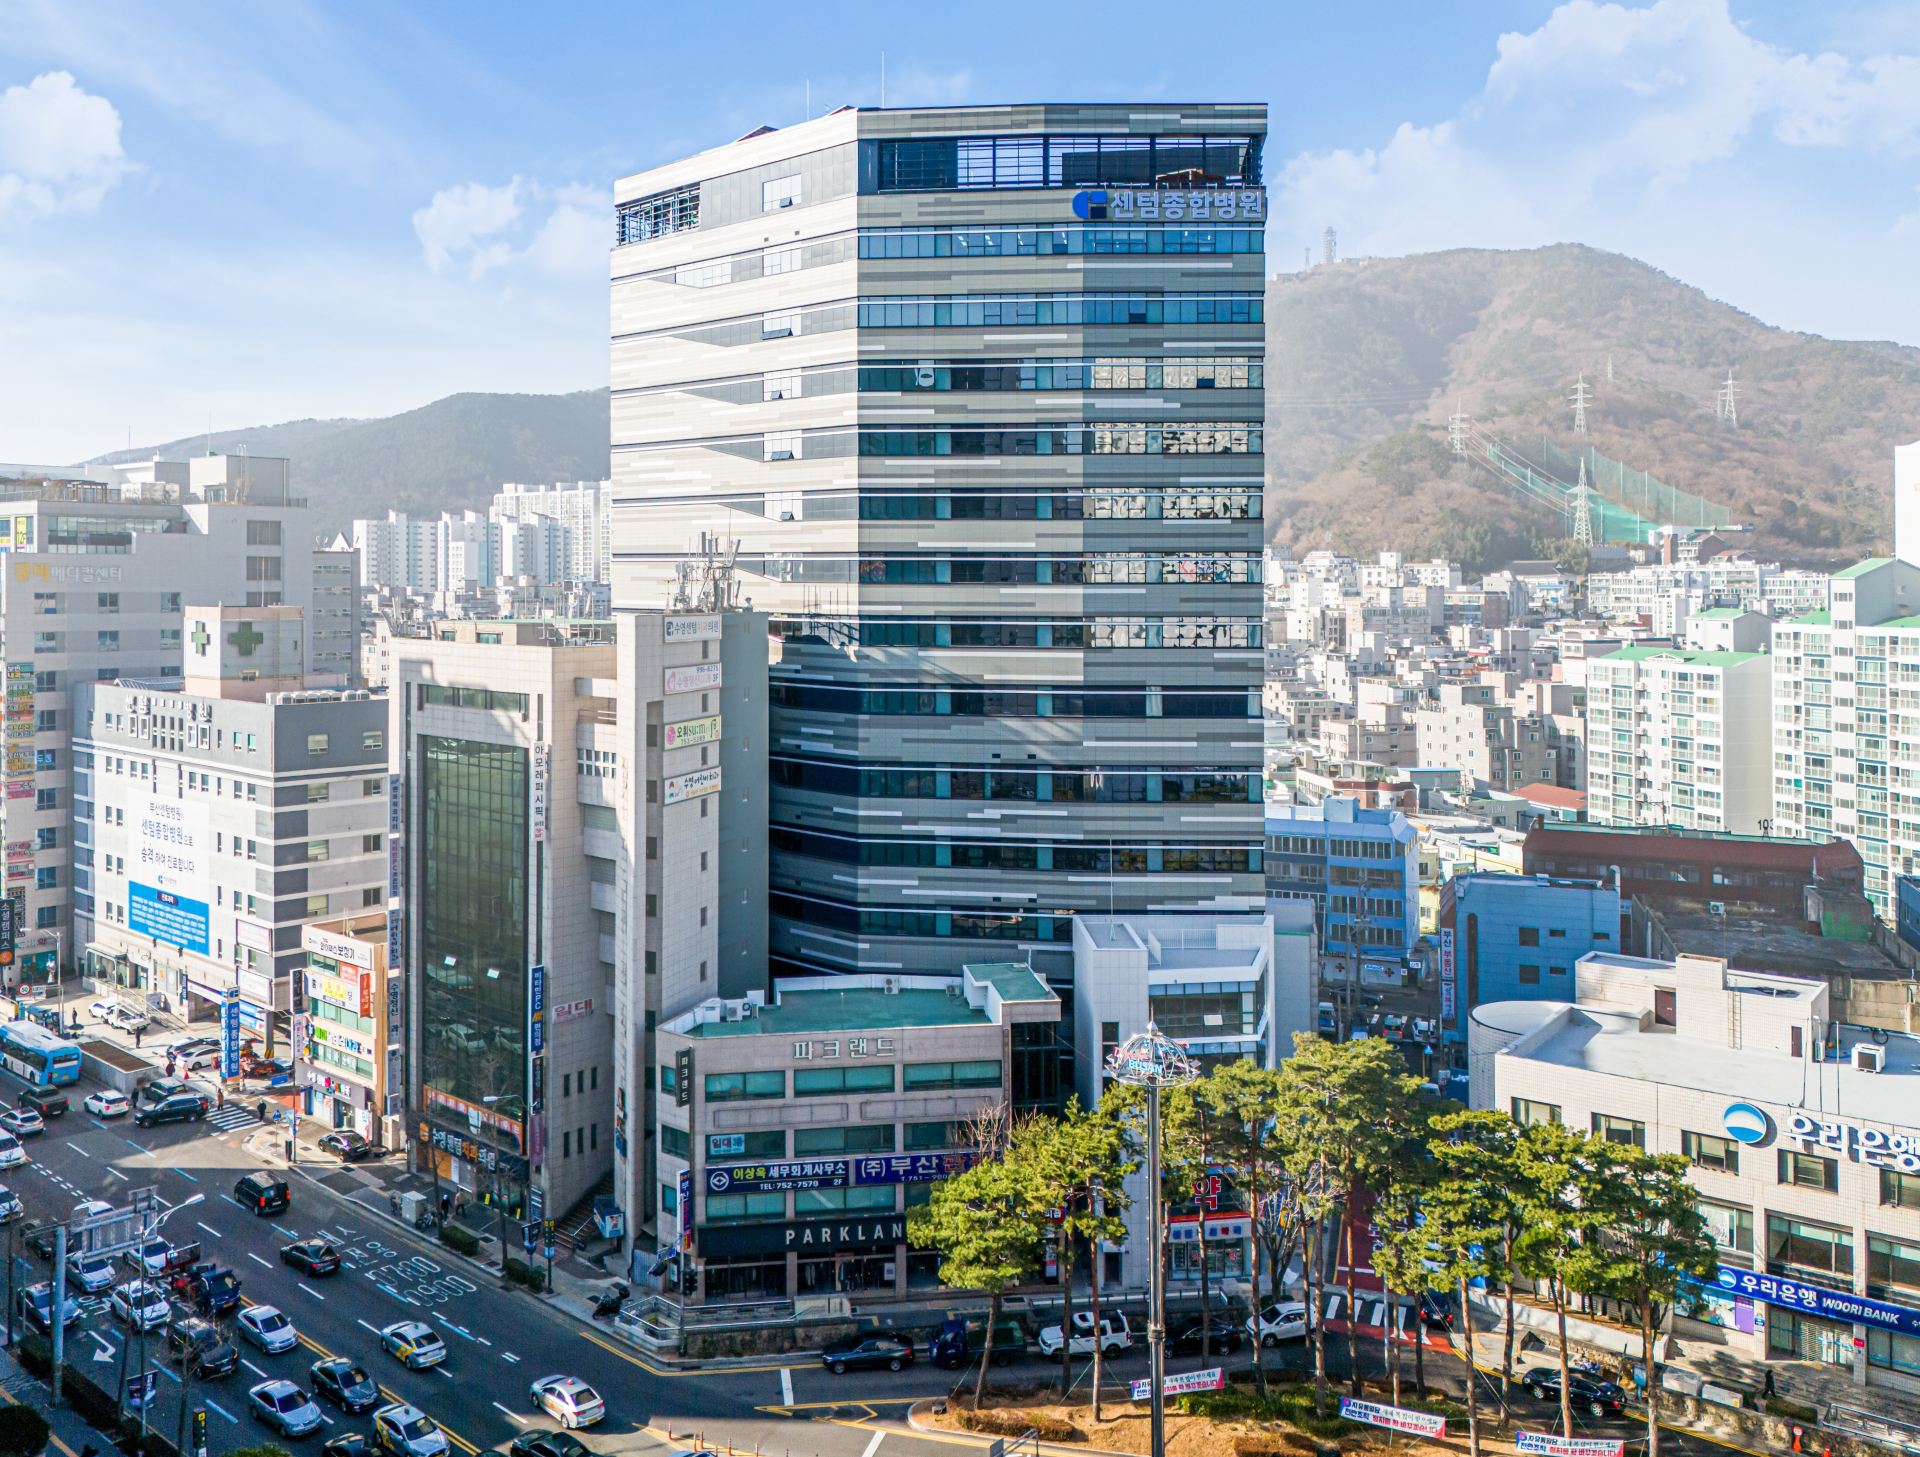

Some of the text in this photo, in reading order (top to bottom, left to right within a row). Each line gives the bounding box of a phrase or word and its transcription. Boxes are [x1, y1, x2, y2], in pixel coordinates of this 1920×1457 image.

[1110, 191, 1262, 219] 센텀종합병원
[535, 745, 544, 816] 아모레퍼시픽
[1443, 930, 1453, 948] 부산
[1443, 951, 1453, 976] 부동산
[554, 998, 593, 1017] 임대
[793, 1038, 895, 1060] 파크랜드
[680, 1056, 688, 1101] 파크랜드
[711, 1137, 731, 1148] 임대
[1783, 1113, 1920, 1172] 우리은행
[769, 1162, 846, 1178] 세무회계사무소
[785, 1222, 902, 1246] PARKLAN
[1740, 1274, 1817, 1308] 우리은행
[1822, 1297, 1863, 1316] WOORI
[1863, 1307, 1900, 1324] BANK
[1351, 1401, 1380, 1414] 자유통일당
[1400, 1421, 1438, 1434] 바꾸겠습니다
[1527, 1435, 1558, 1446] 자유통일당
